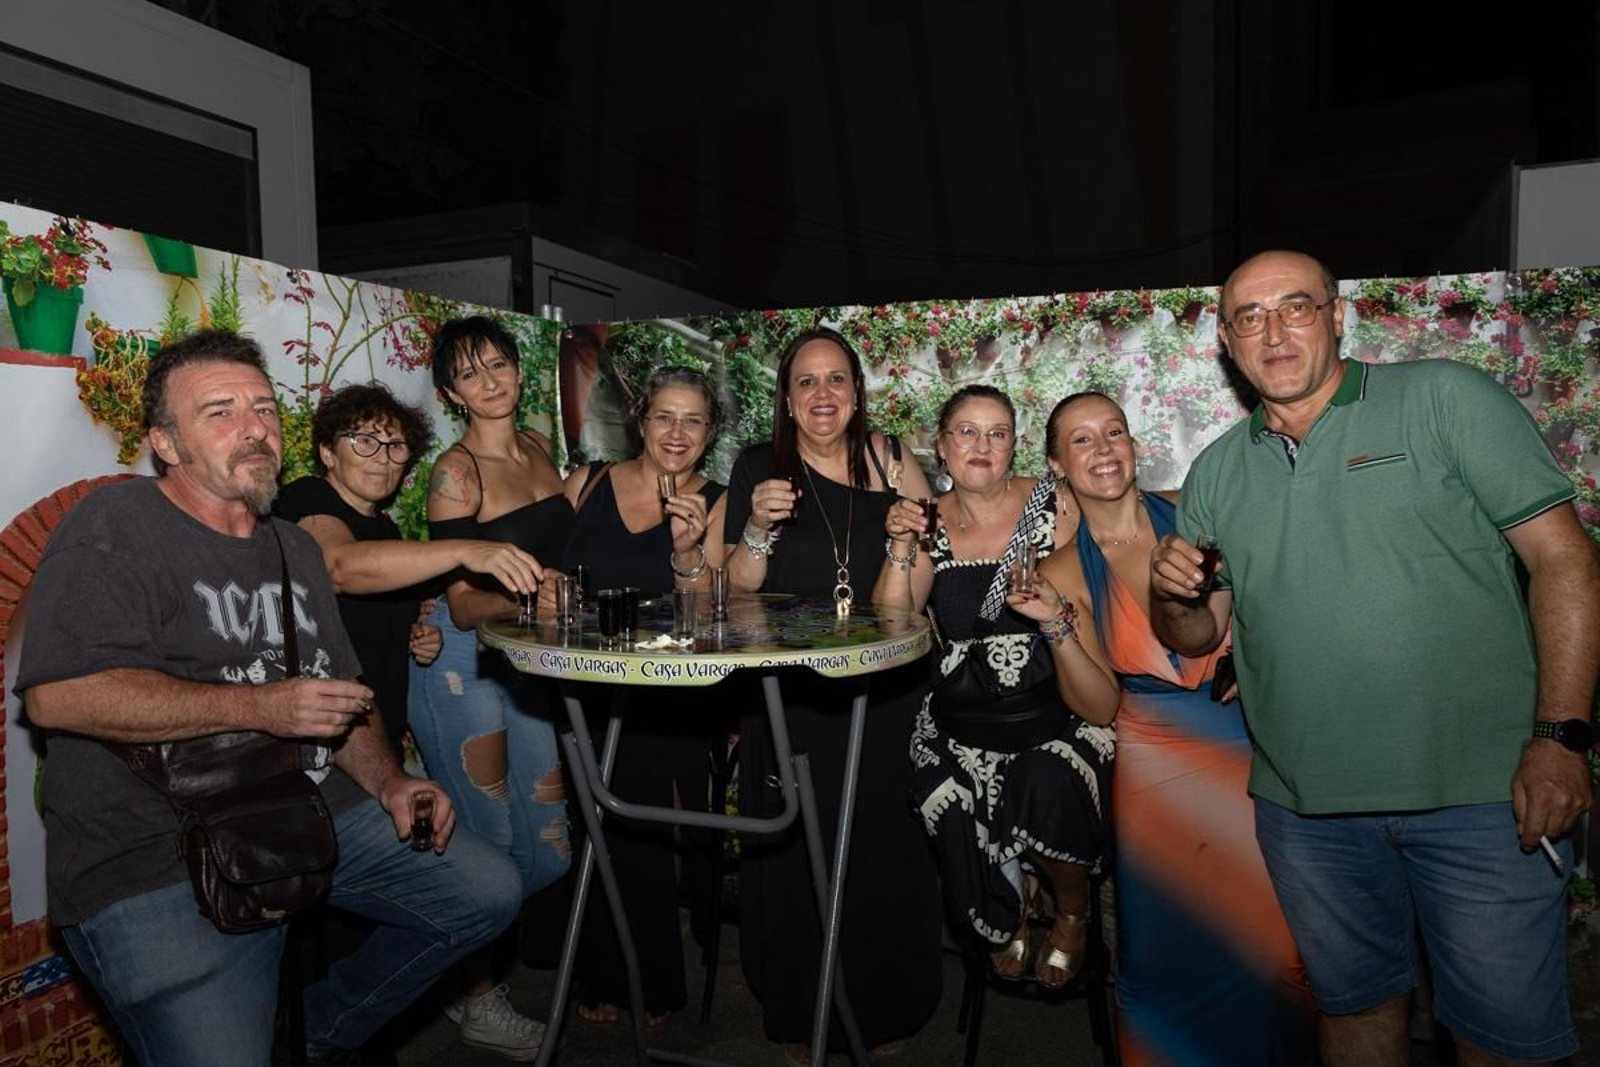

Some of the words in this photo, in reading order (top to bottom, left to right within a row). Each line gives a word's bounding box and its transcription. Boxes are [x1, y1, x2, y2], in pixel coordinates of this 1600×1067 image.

[540, 651, 571, 673] CASA
[574, 656, 627, 681] VARGAS
[640, 660, 682, 682] CASA
